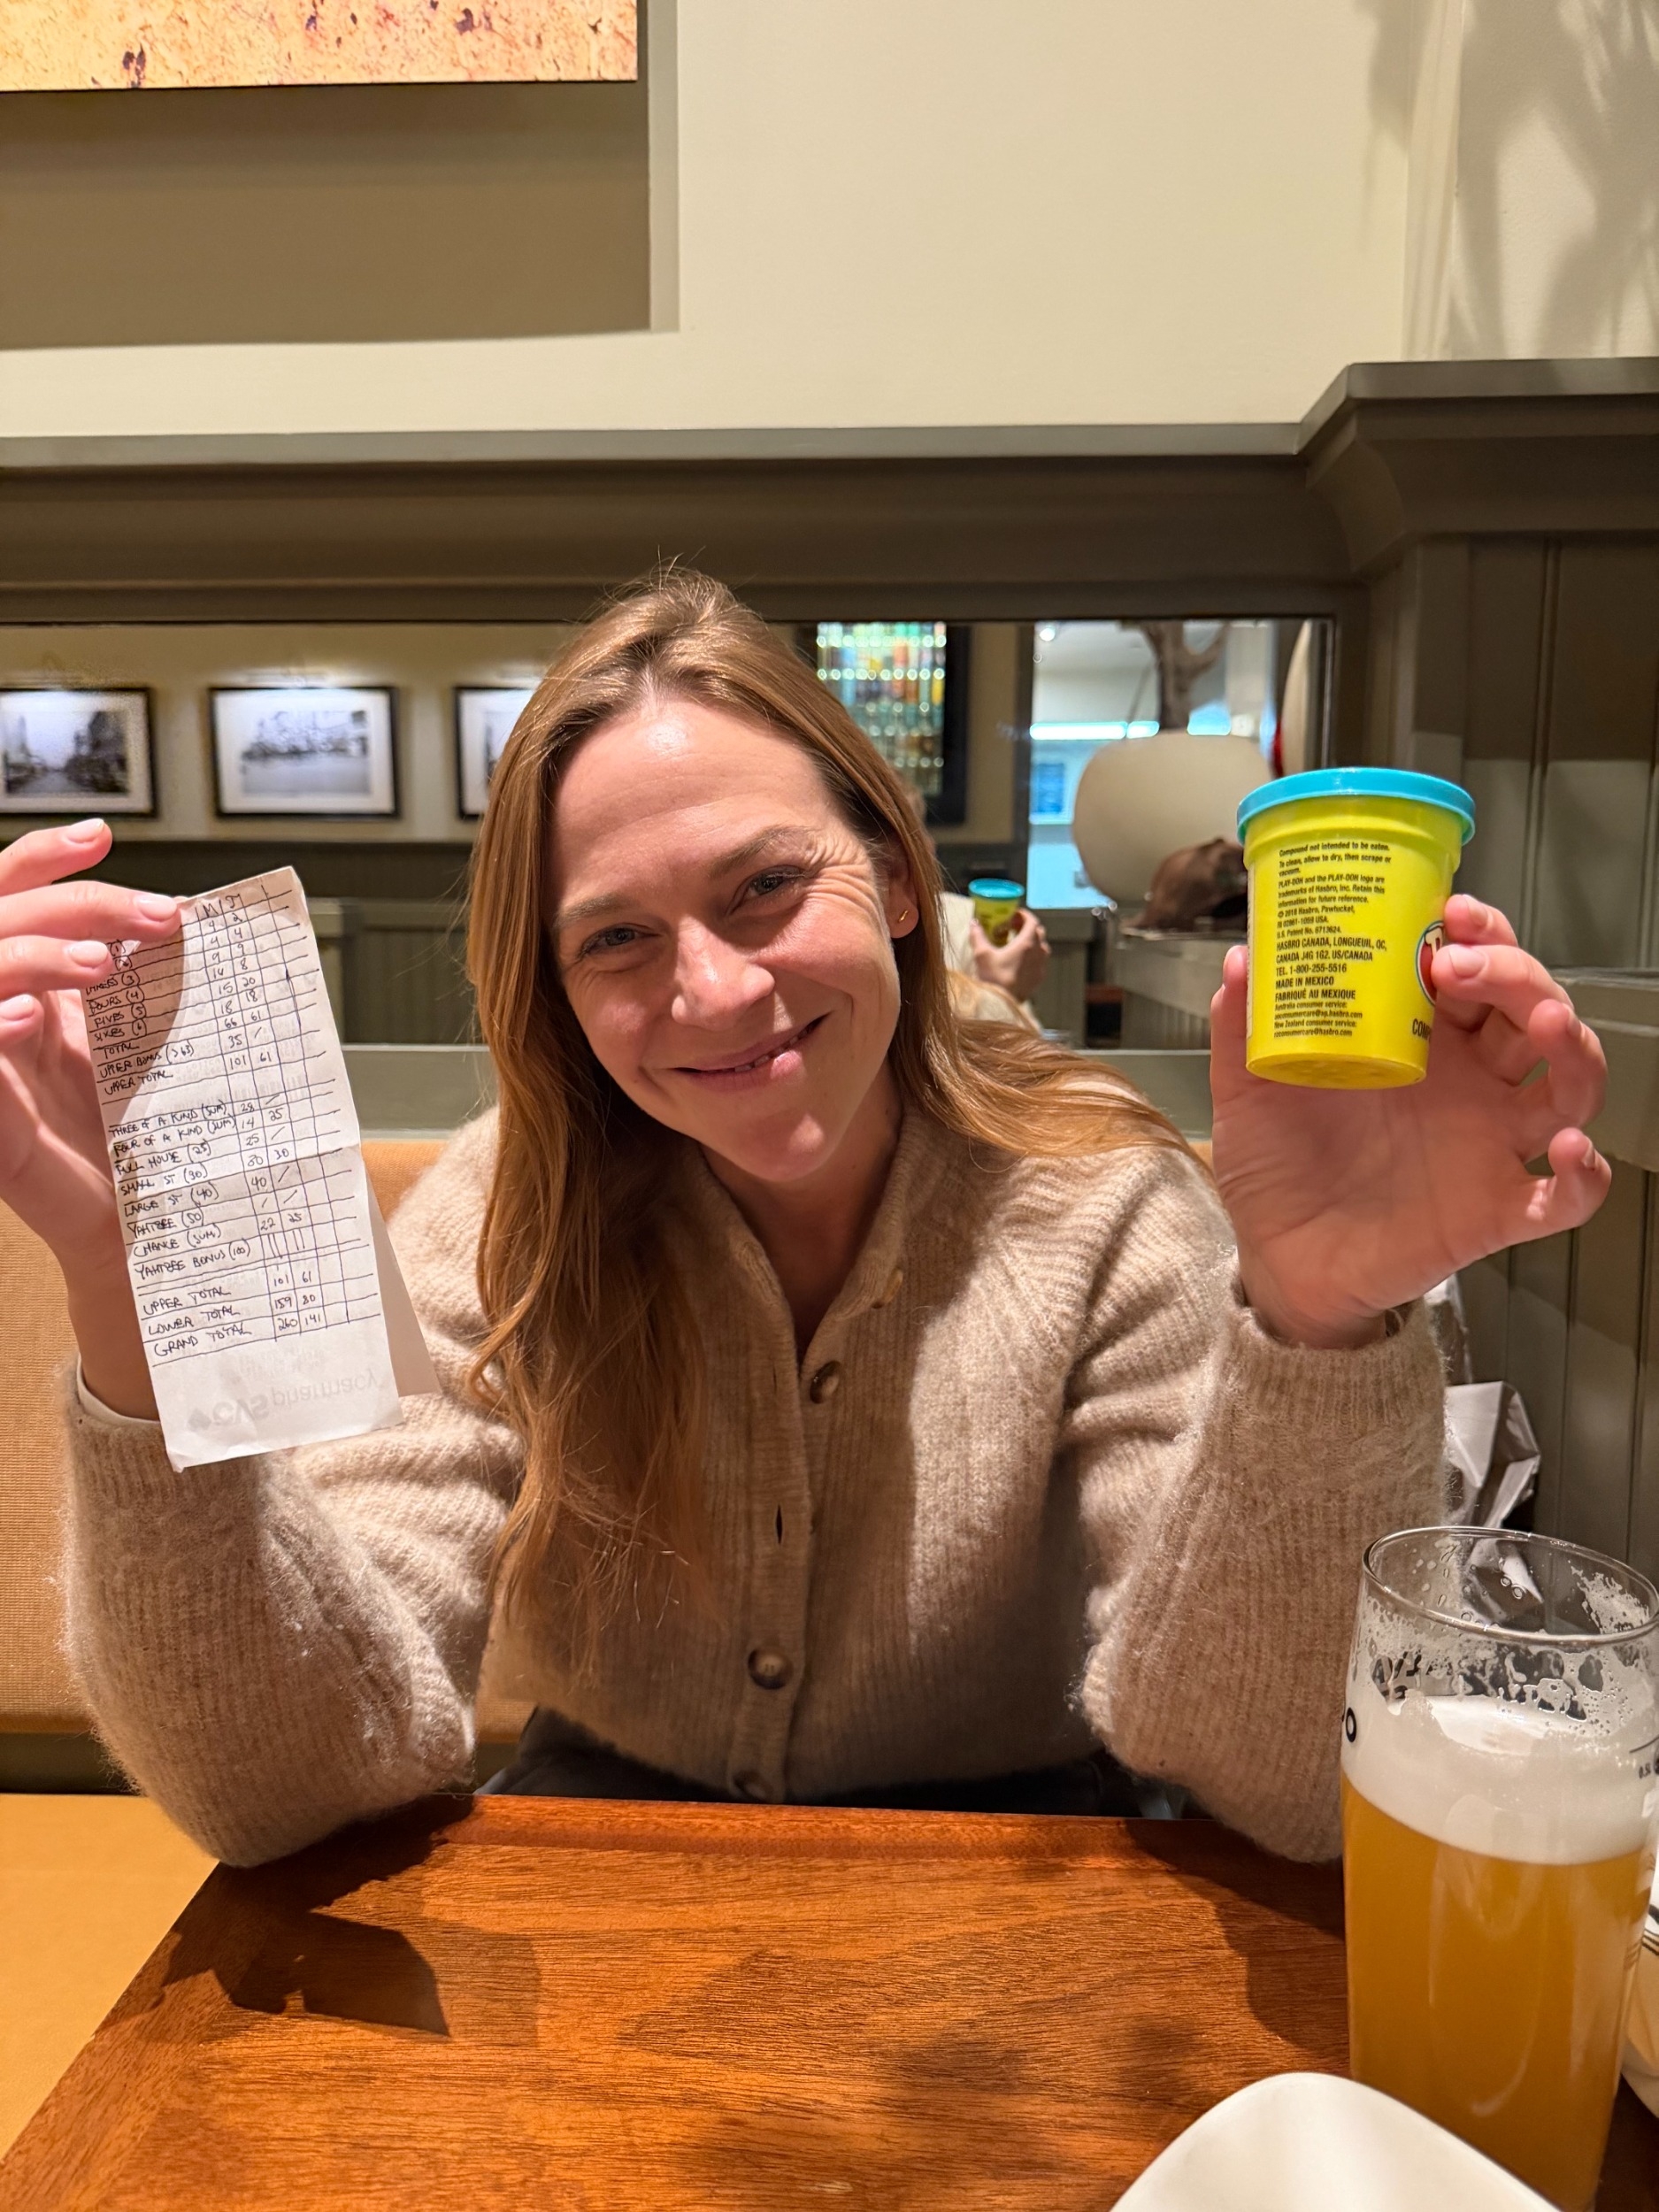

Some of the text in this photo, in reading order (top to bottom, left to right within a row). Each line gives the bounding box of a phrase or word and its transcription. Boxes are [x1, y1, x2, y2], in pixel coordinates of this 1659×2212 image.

[1279, 845, 1308, 856] Compound
[1331, 853, 1342, 862] dry,
[1279, 868, 1301, 877] vacuum.
[1279, 878, 1303, 888] PLAY-DOH
[1361, 874, 1373, 883] logo
[1279, 887, 1307, 898] trademarks
[1316, 885, 1338, 894] Hasbro,
[204, 904, 219, 917] M
[1279, 897, 1307, 908] information
[1277, 937, 1386, 951] HASBRO CANADA, LONGUEUIL, QC,
[1276, 950, 1373, 964] CANADA J4G 1G2. US/CANADA
[1276, 964, 1347, 977] TEL. 1-800-255-5516
[89, 996, 121, 1016] FOURS
[126, 985, 144, 1002] (4)
[241, 958, 248, 970] 8
[1276, 978, 1293, 989] MADE
[1305, 976, 1334, 986] MEXICO
[94, 1011, 125, 1028] FIVES
[219, 983, 233, 995] 15
[243, 977, 256, 987] 20
[1276, 987, 1356, 1002] FABRIQUÉ AU MEXIQUE
[95, 1027, 125, 1041] SIXES
[221, 1001, 233, 1014] 18
[246, 990, 257, 1002] 18
[1275, 1002, 1295, 1010] Australia
[1286, 1019, 1304, 1028] Zealand
[102, 1010, 261, 1060] TOTAL 66 61
[100, 1060, 132, 1078] UPPER
[229, 1034, 242, 1048] 35
[104, 1052, 272, 1095] UPPER TOTAL 101 61
[110, 1125, 139, 1139] THREE
[171, 1110, 198, 1122] KIND
[241, 1103, 255, 1112] 28
[113, 1141, 140, 1156] FOUR
[178, 1125, 202, 1141] KIND
[242, 1117, 255, 1129] 14
[270, 1108, 283, 1121] 25
[116, 1162, 143, 1175] FULL
[188, 1139, 211, 1164] (25)
[246, 1134, 259, 1146] 25
[120, 1179, 155, 1195] SMALL
[165, 1174, 175, 1185] ST
[184, 1162, 208, 1184] (30)
[276, 1149, 289, 1160] 30
[124, 1201, 159, 1217] LARGE
[190, 1180, 219, 1207] (40)
[251, 1177, 266, 1191] 40
[181, 1207, 204, 1228] (50)
[261, 1218, 276, 1231] 22
[288, 1213, 302, 1223] 25
[193, 1249, 226, 1268] BONUS
[143, 1271, 311, 1316] UPPER TOTAL 101 61
[148, 1294, 316, 1335] LOWER TOTAL 159 80
[154, 1314, 320, 1356] GRAND TOTAL 260 141
